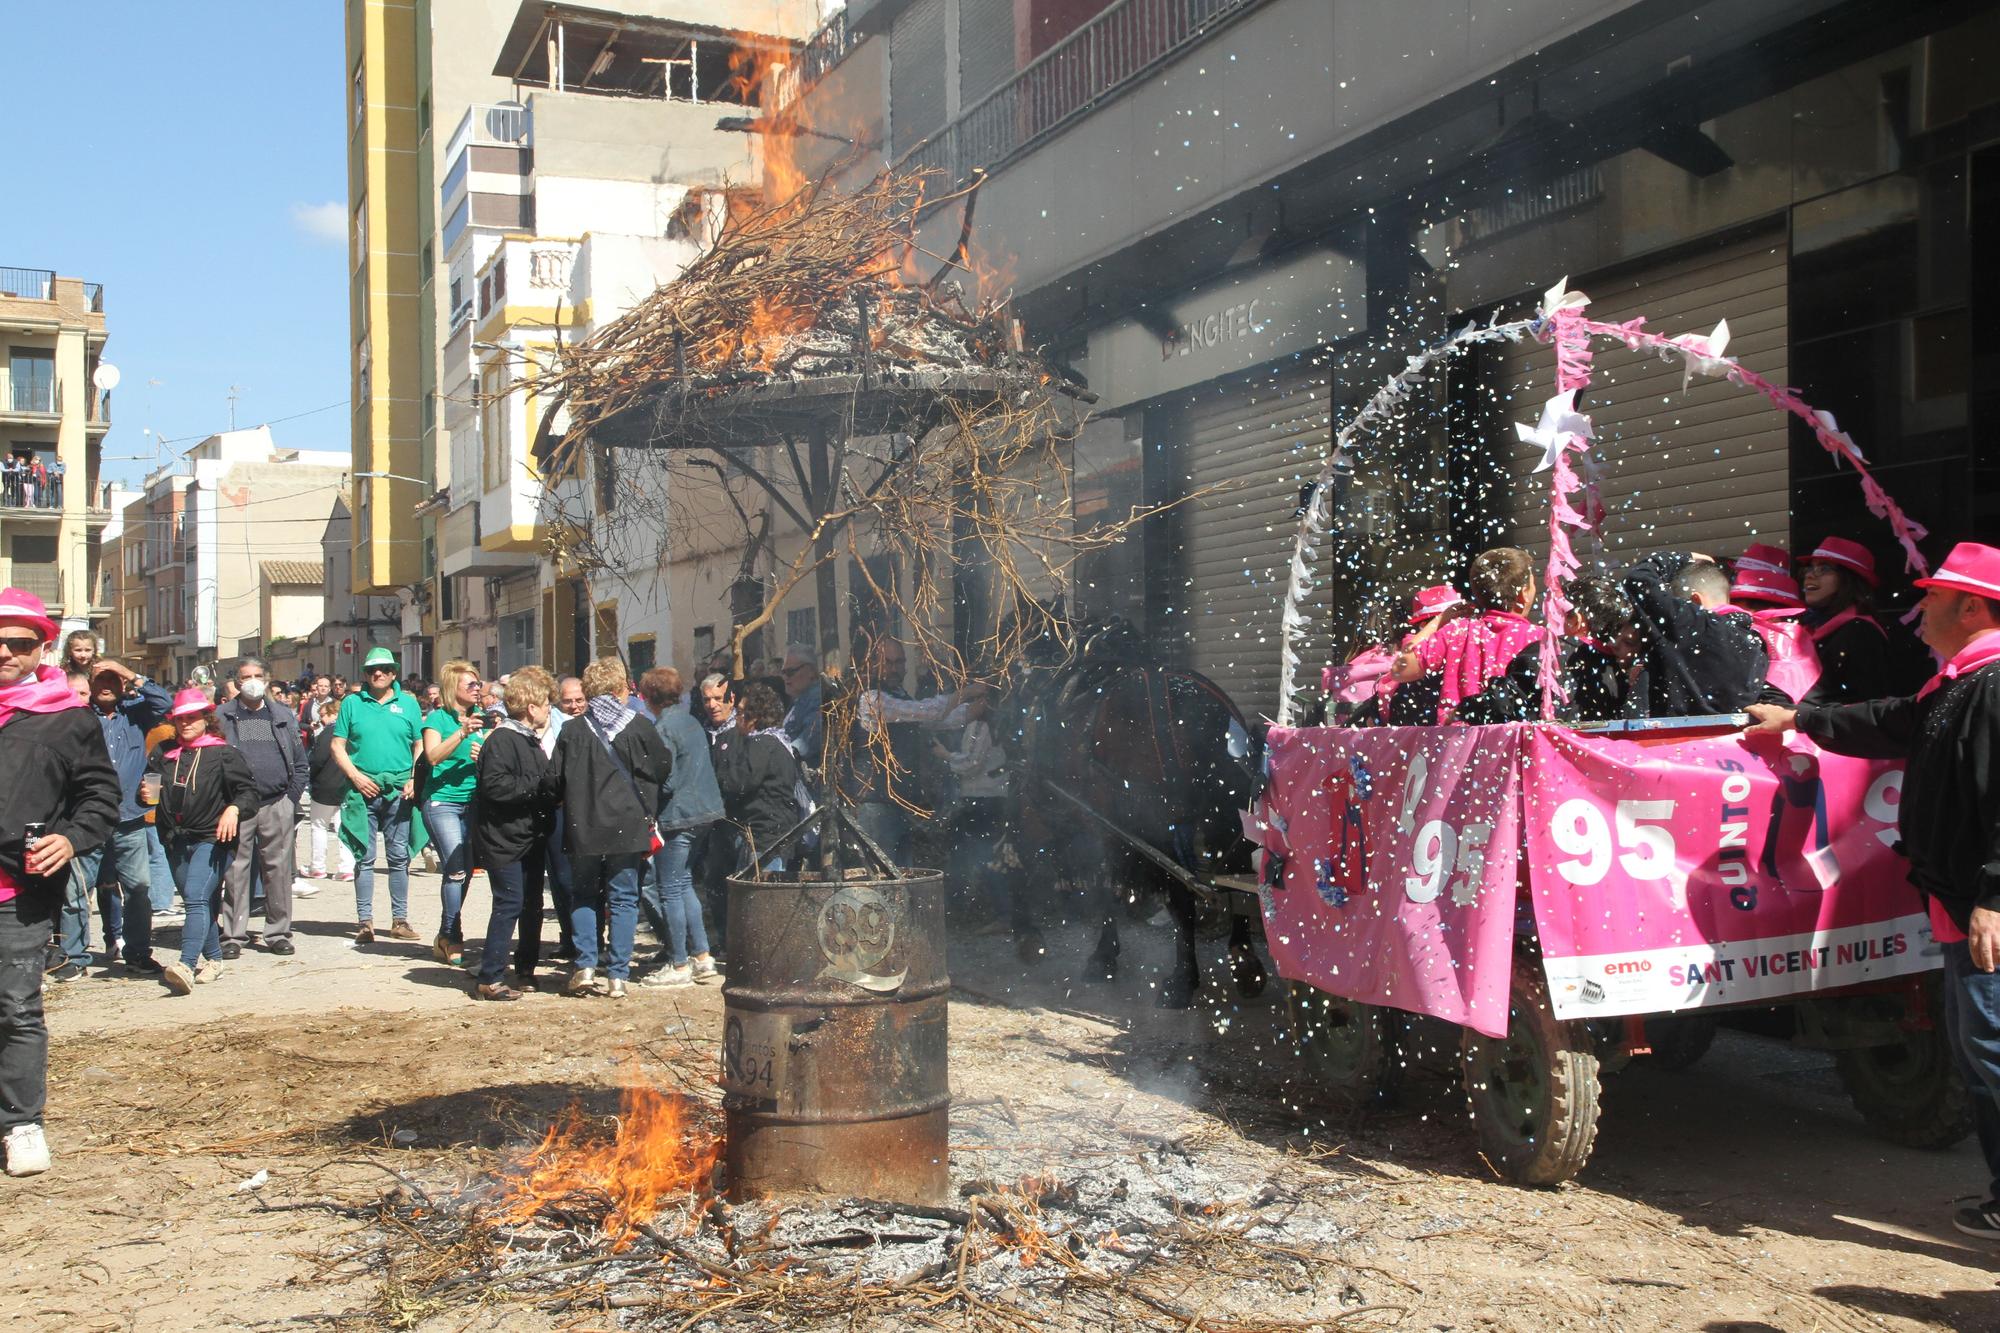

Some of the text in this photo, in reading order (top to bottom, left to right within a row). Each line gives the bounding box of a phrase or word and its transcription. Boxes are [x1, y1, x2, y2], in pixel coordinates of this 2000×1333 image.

[1405, 819, 1491, 906] 95
[1551, 798, 1676, 886] 95
[1716, 758, 1759, 912] QUINTOS
[1604, 960, 1652, 975] emo
[1668, 933, 1908, 986] SANT VICENT NULES
[746, 1058, 774, 1089] 94
